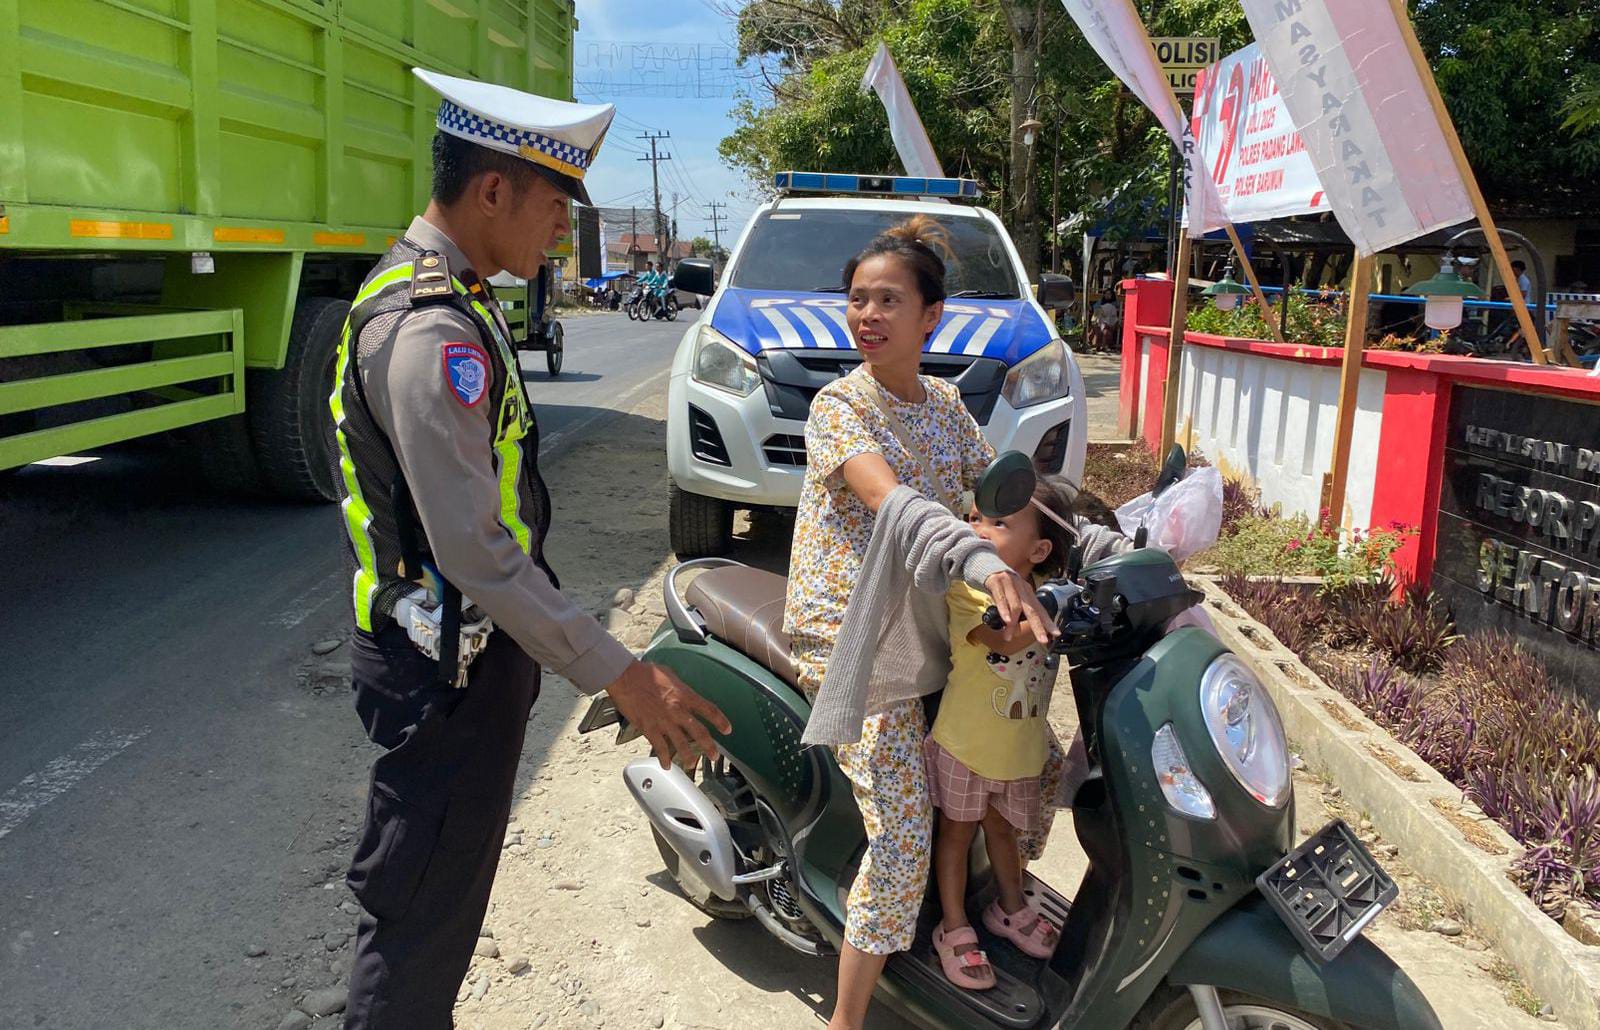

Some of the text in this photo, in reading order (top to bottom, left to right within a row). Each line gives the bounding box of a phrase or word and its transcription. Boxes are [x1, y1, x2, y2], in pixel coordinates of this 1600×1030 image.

[1152, 42, 1215, 64] OLISI
[415, 286, 447, 295] POLISI
[750, 298, 1013, 319] POSI
[1476, 473, 1572, 538] RESOR
